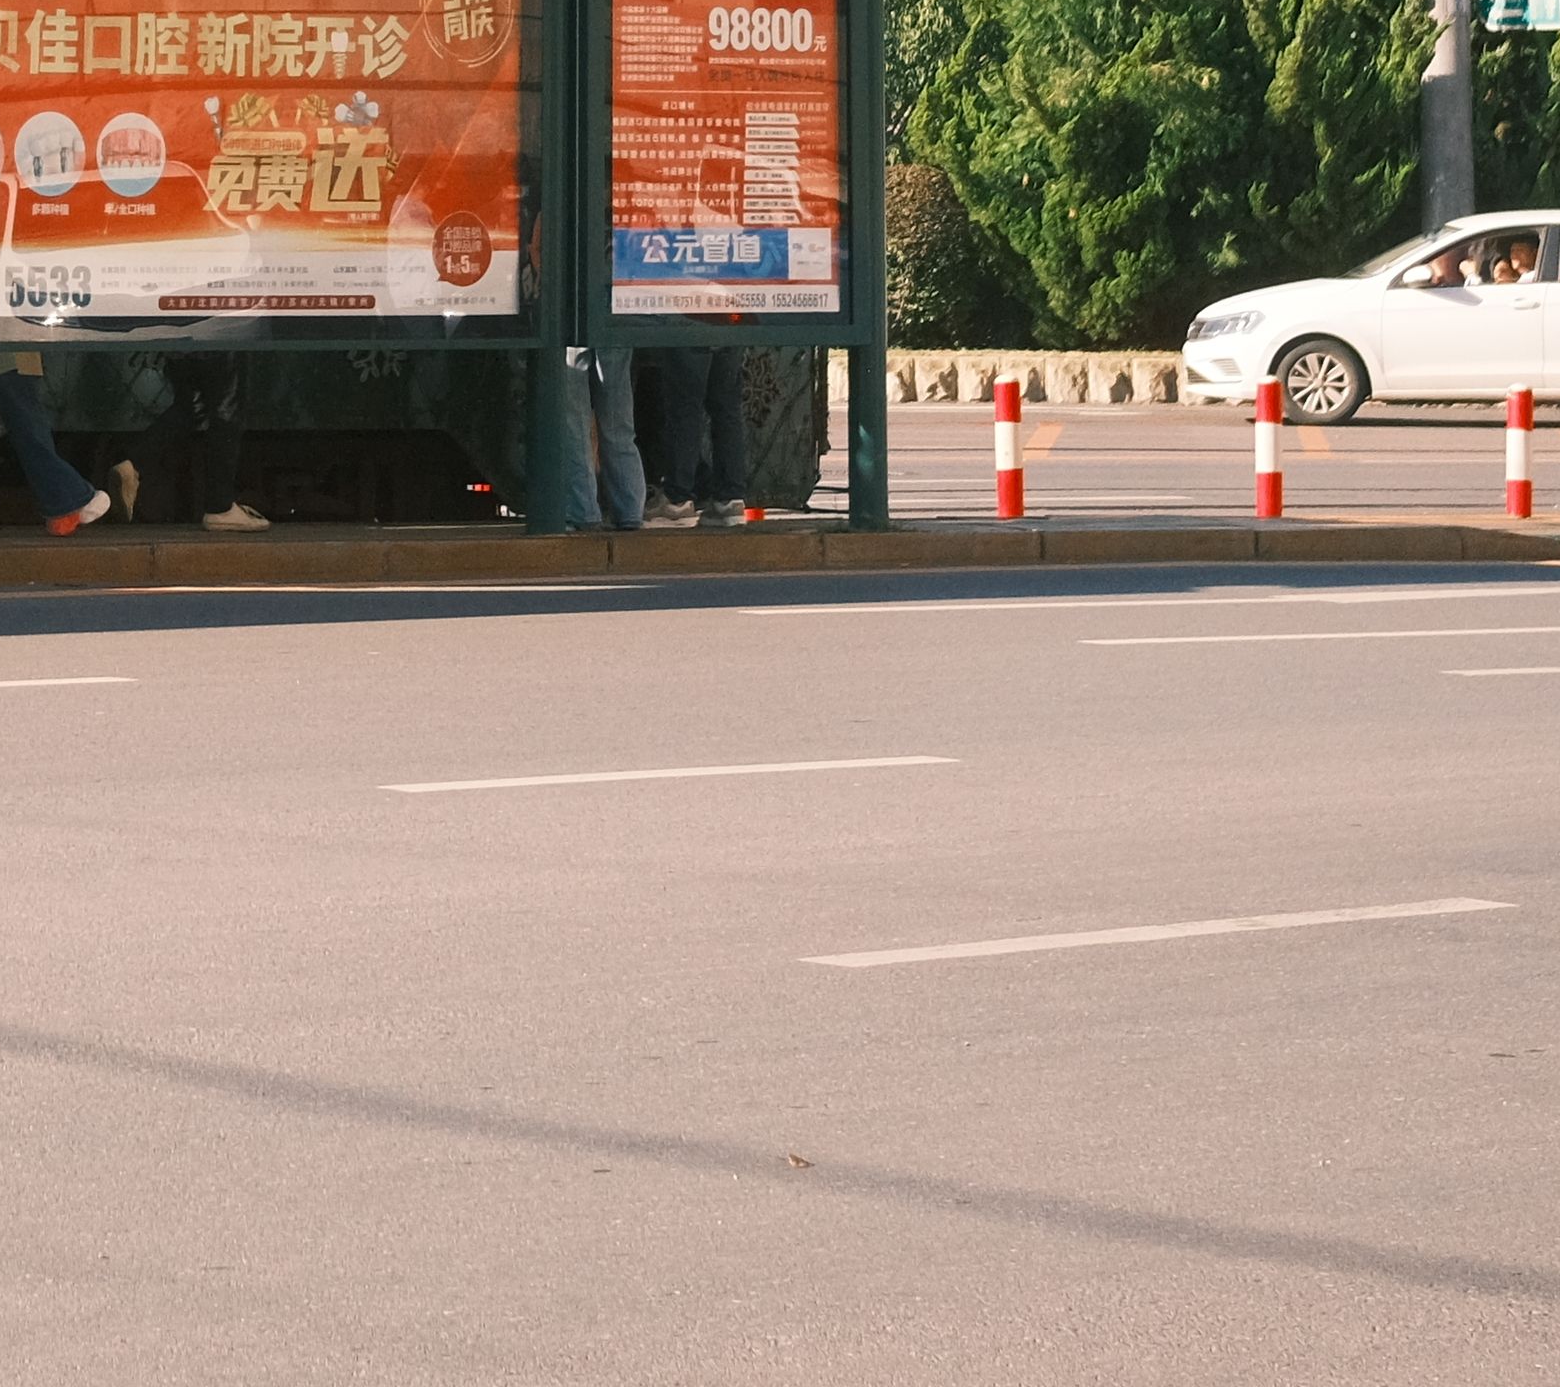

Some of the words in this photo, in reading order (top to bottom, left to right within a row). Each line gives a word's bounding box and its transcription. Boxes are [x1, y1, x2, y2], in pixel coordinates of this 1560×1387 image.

[443, 6, 495, 44] 同庆
[202, 127, 389, 212] 免费送
[640, 234, 761, 264] 公元管道
[5, 265, 92, 308] 5533
